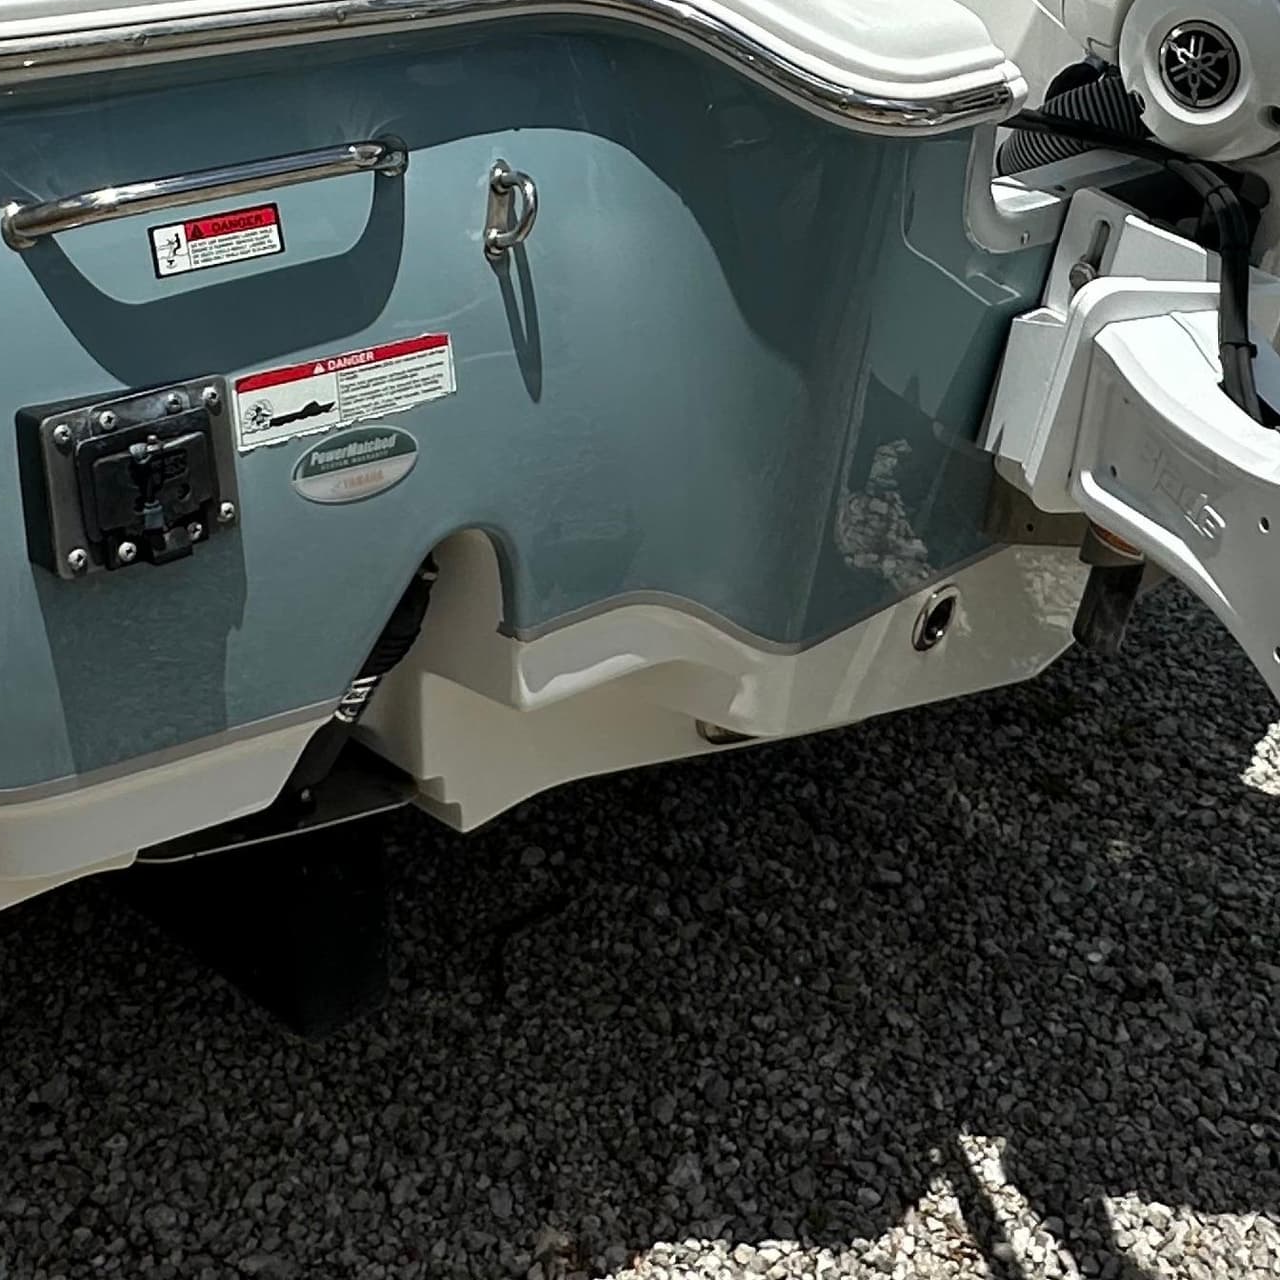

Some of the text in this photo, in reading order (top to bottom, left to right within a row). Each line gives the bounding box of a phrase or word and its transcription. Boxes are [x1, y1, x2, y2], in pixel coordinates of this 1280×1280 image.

[210, 214, 263, 235] DANGER
[327, 351, 375, 371] DANGER
[310, 433, 399, 466] PowerMatched
